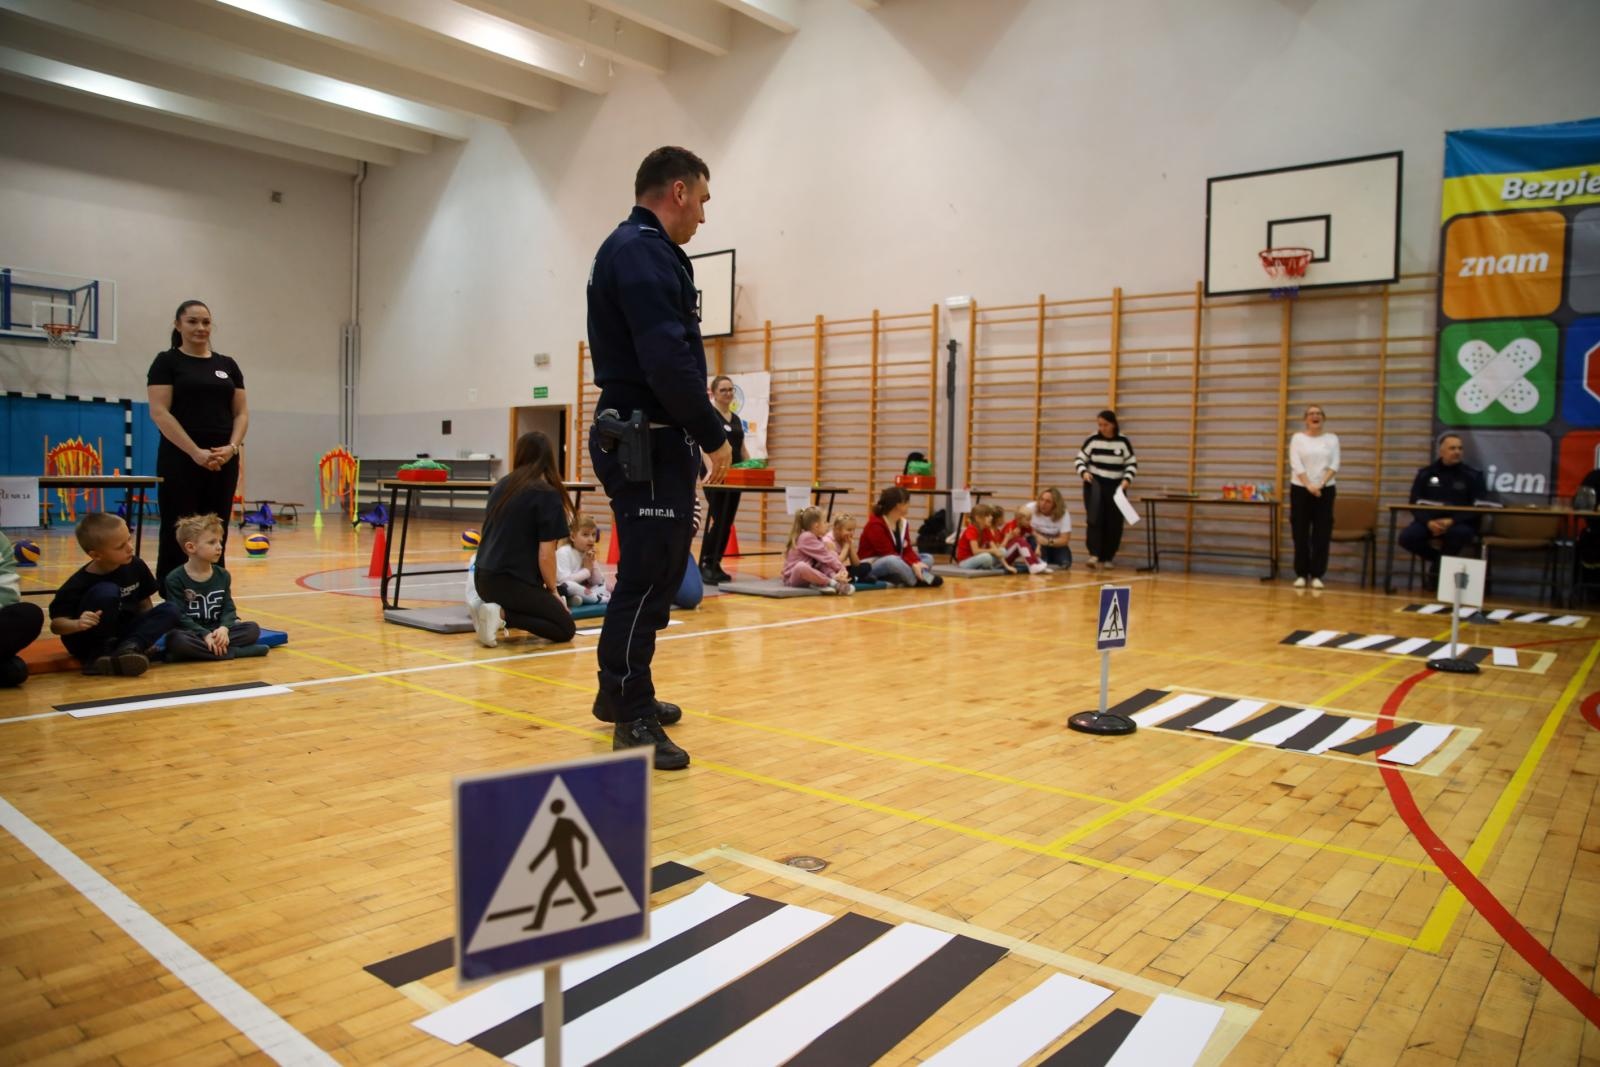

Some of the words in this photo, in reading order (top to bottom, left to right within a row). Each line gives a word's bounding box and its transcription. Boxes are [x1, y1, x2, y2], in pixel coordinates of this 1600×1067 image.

[1502, 171, 1600, 201] Bezpie
[1458, 252, 1549, 277] znam
[639, 508, 675, 518] POLICJA
